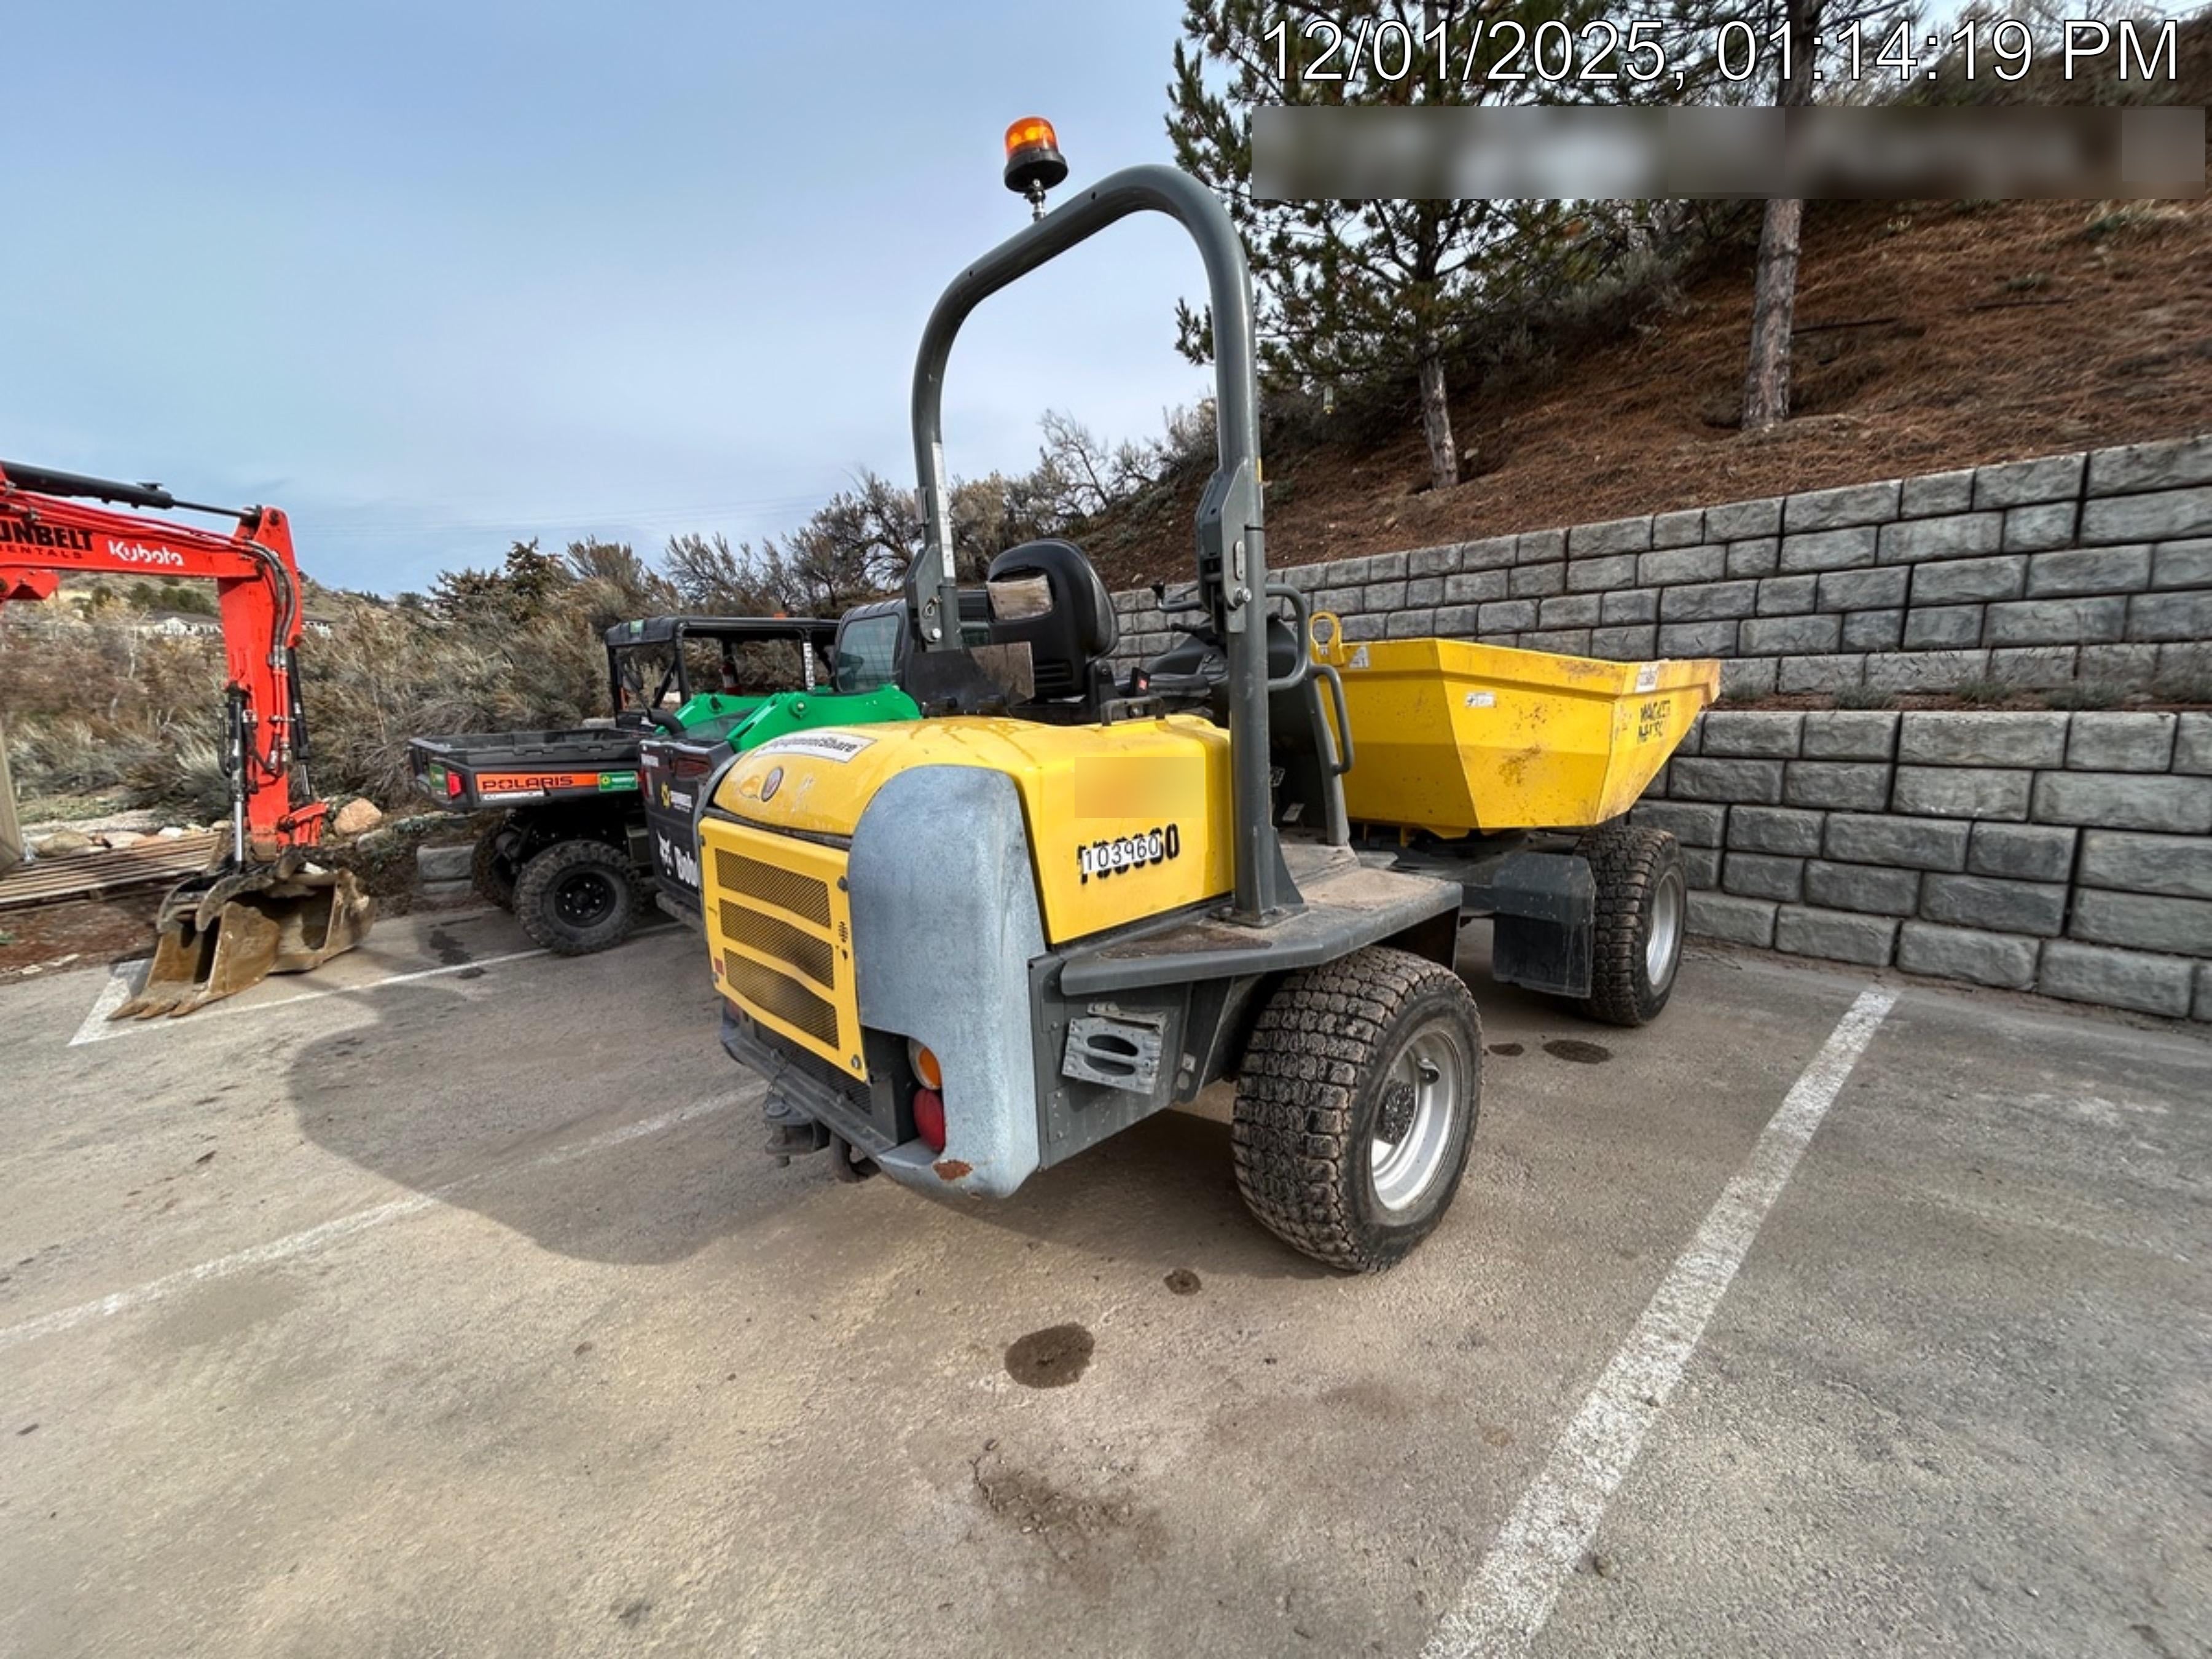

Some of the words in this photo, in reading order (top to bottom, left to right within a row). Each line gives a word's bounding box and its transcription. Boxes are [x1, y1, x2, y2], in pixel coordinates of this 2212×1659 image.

[108, 539, 184, 566] Kubota
[482, 775, 574, 790] POLARIS
[1084, 834, 1159, 871] 103960
